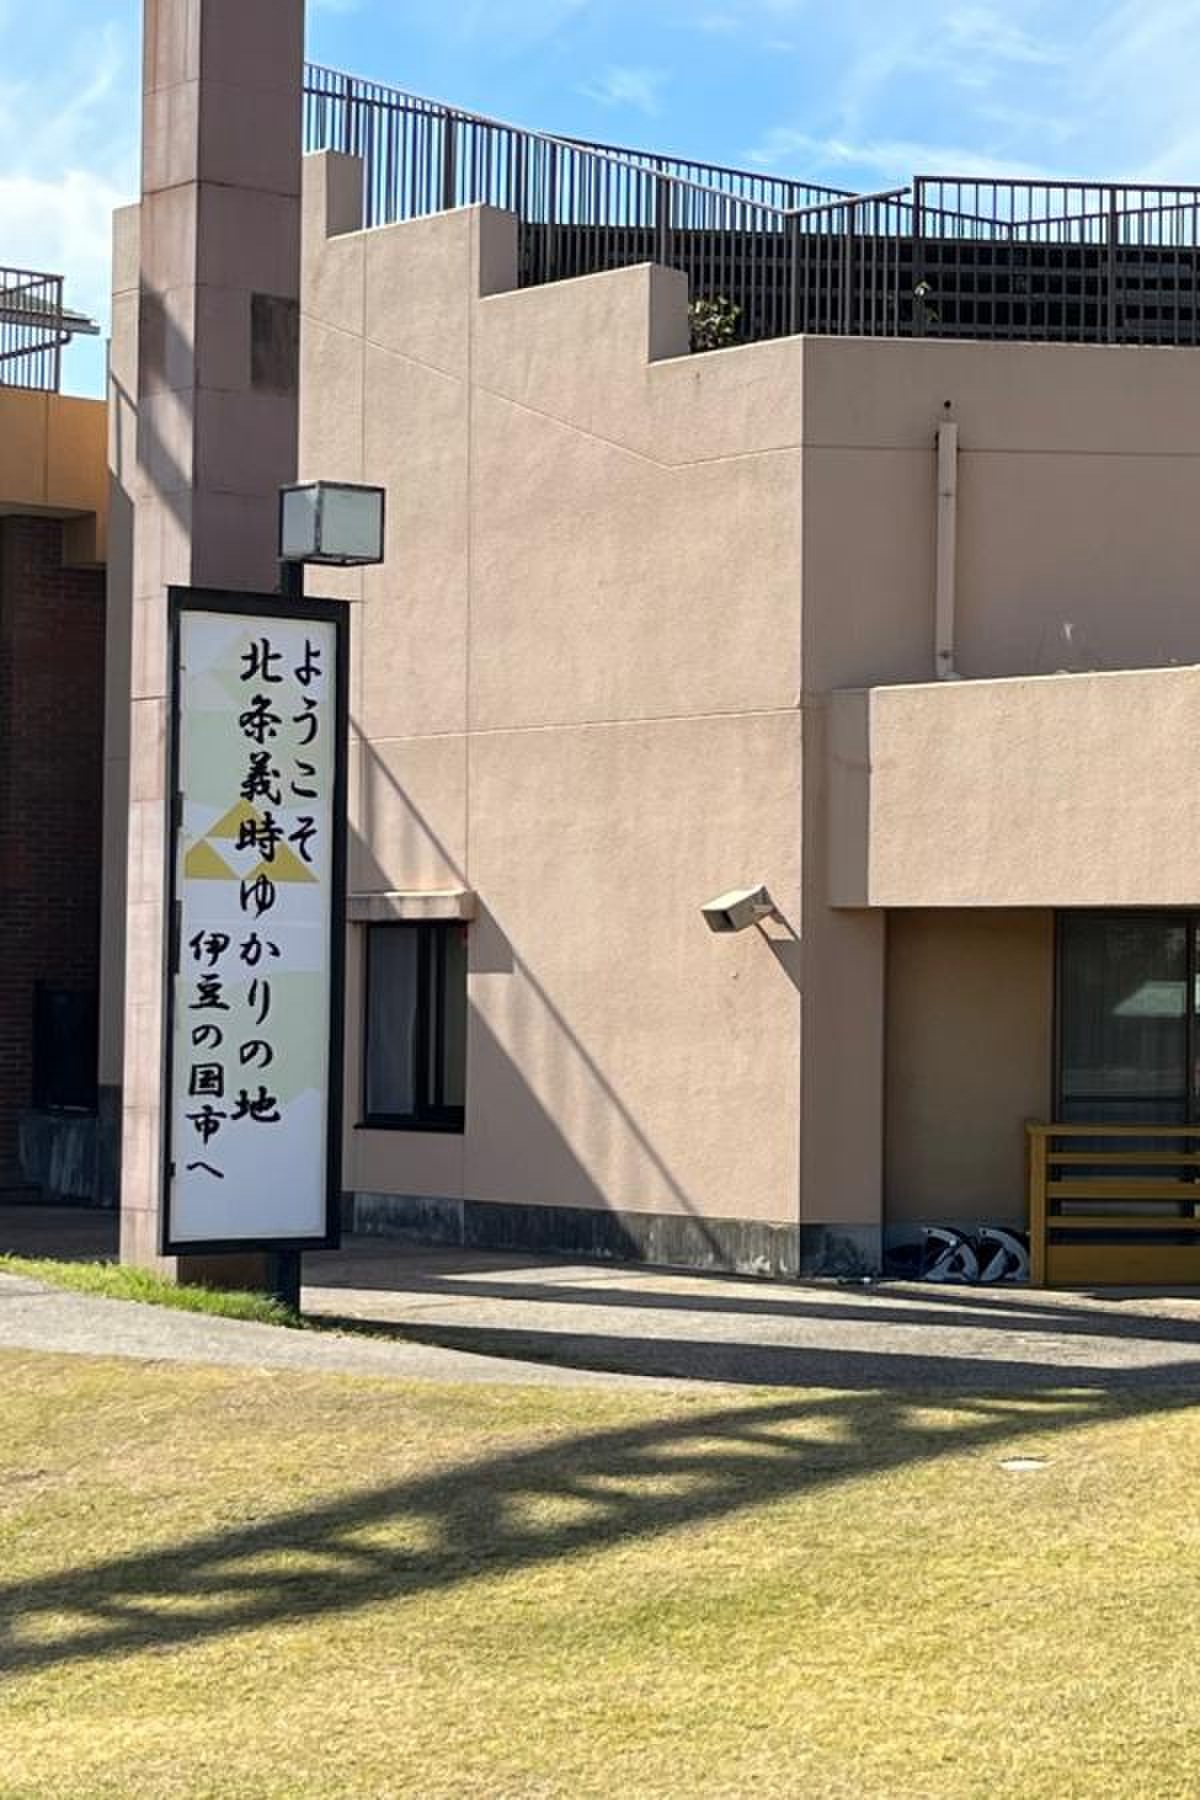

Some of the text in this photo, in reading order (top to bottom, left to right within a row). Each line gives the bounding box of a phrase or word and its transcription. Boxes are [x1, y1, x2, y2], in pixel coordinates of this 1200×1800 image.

[287, 639, 323, 863] ようこそ
[232, 637, 283, 1124] 北条義時ゆかりの地
[186, 930, 231, 1179] 伊豆の国市へ
